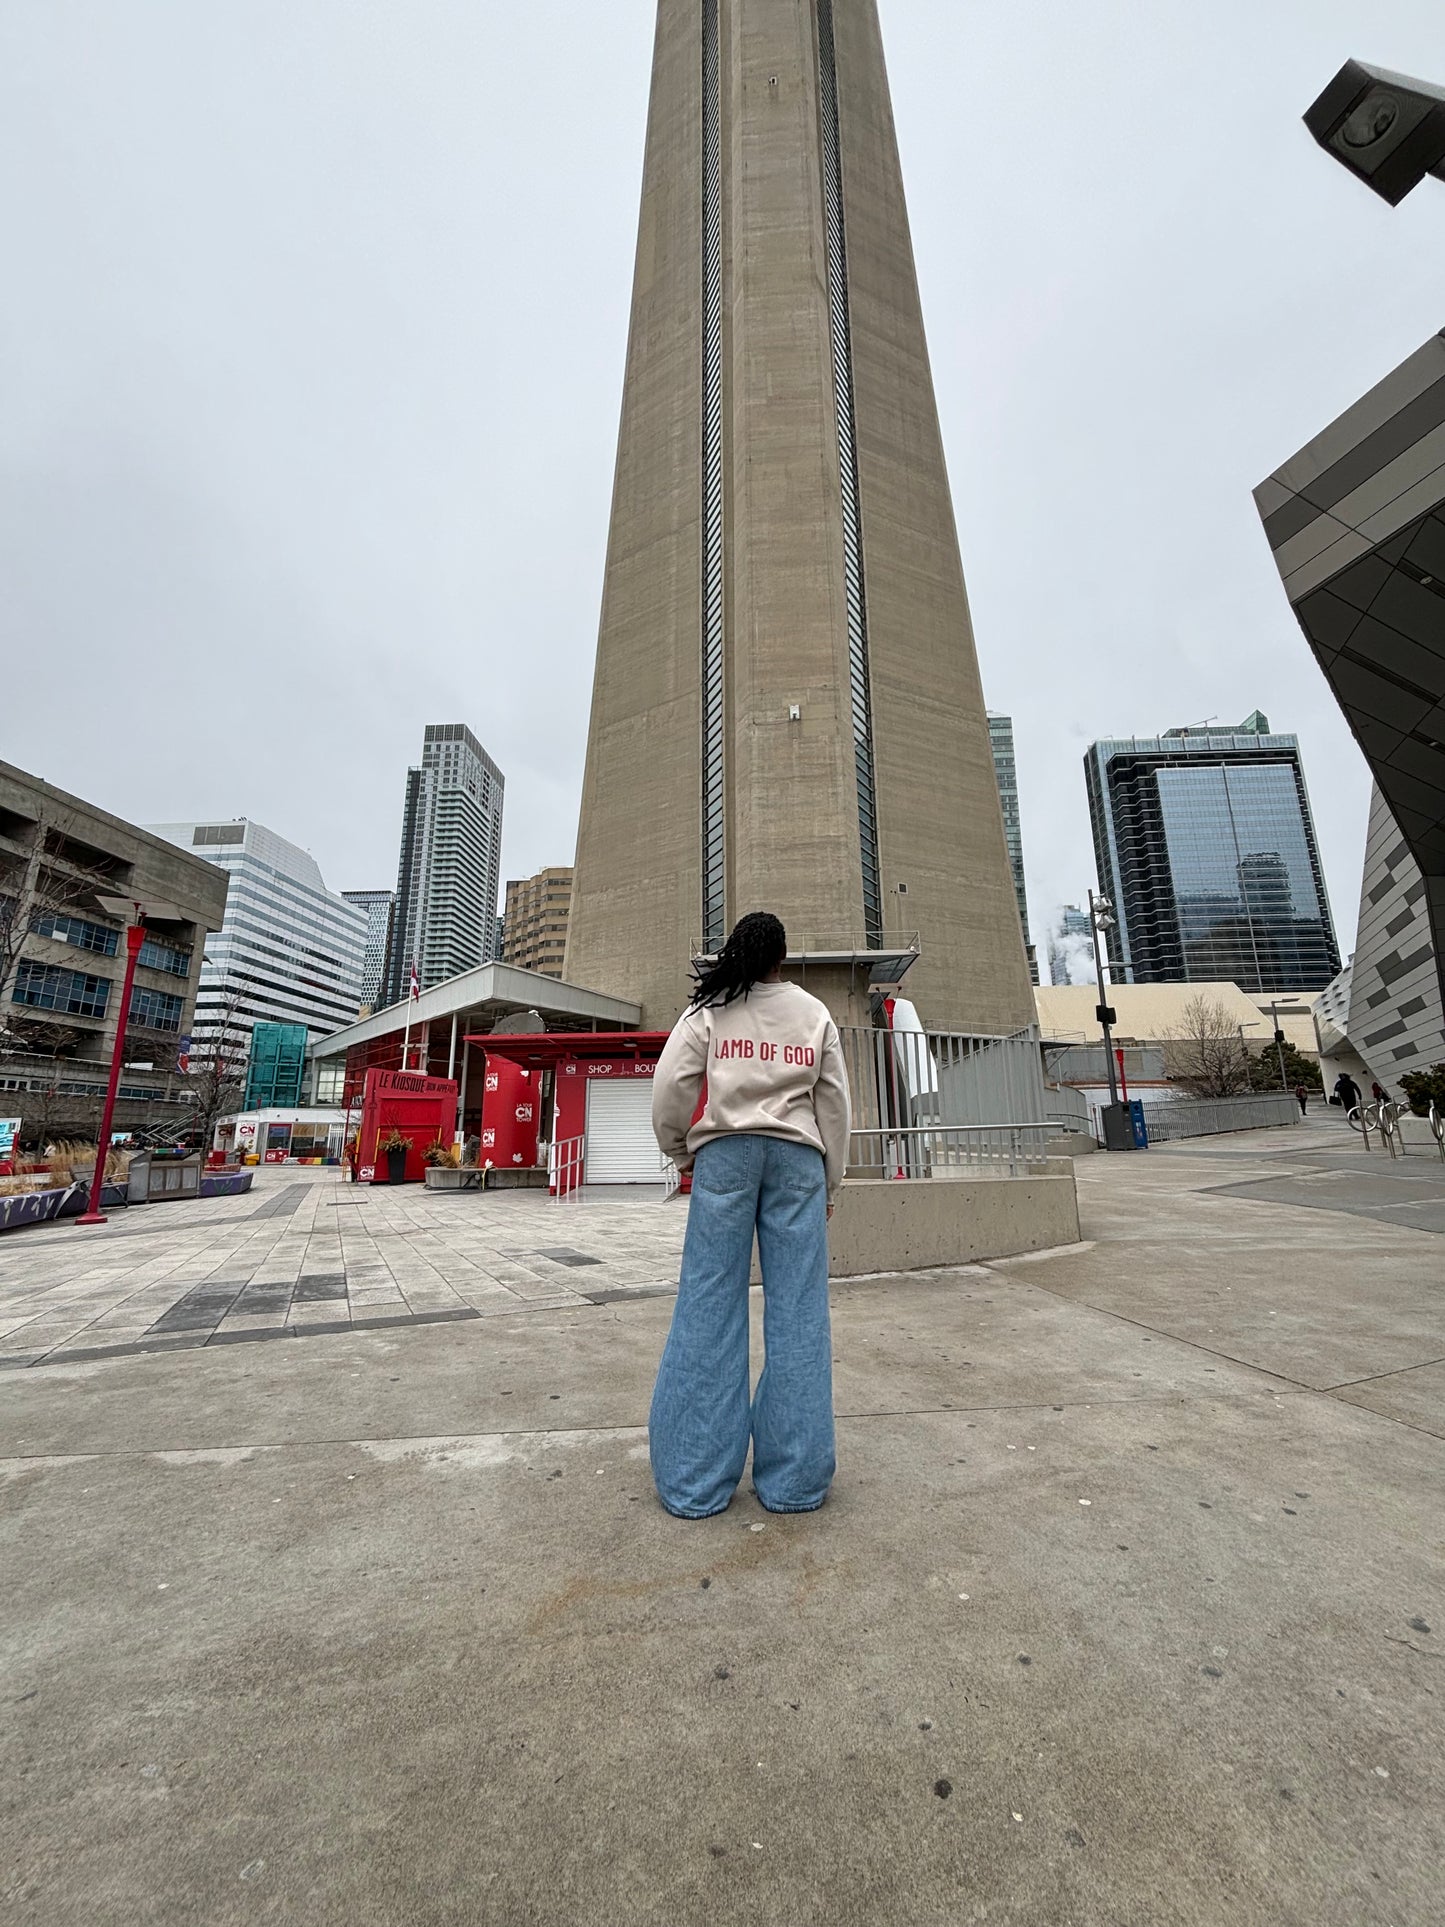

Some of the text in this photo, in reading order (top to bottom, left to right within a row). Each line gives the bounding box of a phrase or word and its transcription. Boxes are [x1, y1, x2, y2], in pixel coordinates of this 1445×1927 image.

[714, 1038, 815, 1067] LAMB OF GOD
[588, 1064, 613, 1074] SHOP
[379, 1071, 391, 1088] LE
[391, 1073, 427, 1093] KIOSQUE
[485, 1076, 498, 1088] CN
[515, 1107, 533, 1118] CN
[239, 1126, 256, 1134] CN
[482, 1132, 495, 1143] CN
[359, 1168, 375, 1177] CN
